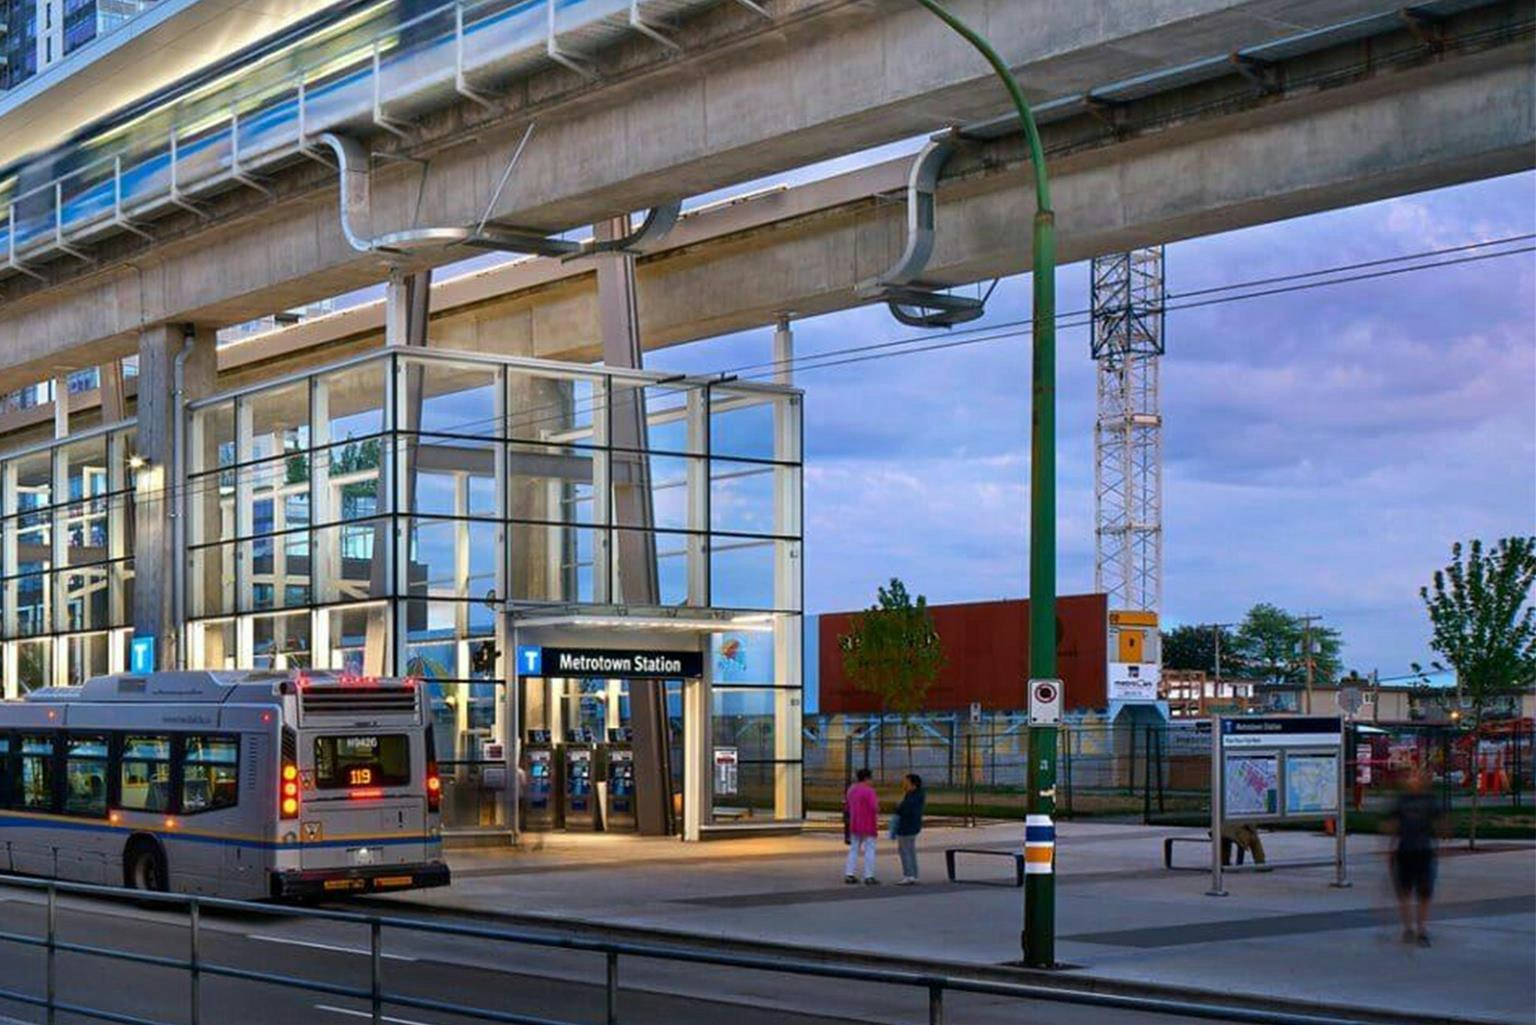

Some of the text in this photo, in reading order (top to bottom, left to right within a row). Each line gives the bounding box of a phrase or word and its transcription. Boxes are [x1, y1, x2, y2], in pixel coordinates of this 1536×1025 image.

[134, 643, 147, 671] T
[525, 651, 682, 673] T Metrotown Station
[350, 768, 372, 784] 119
